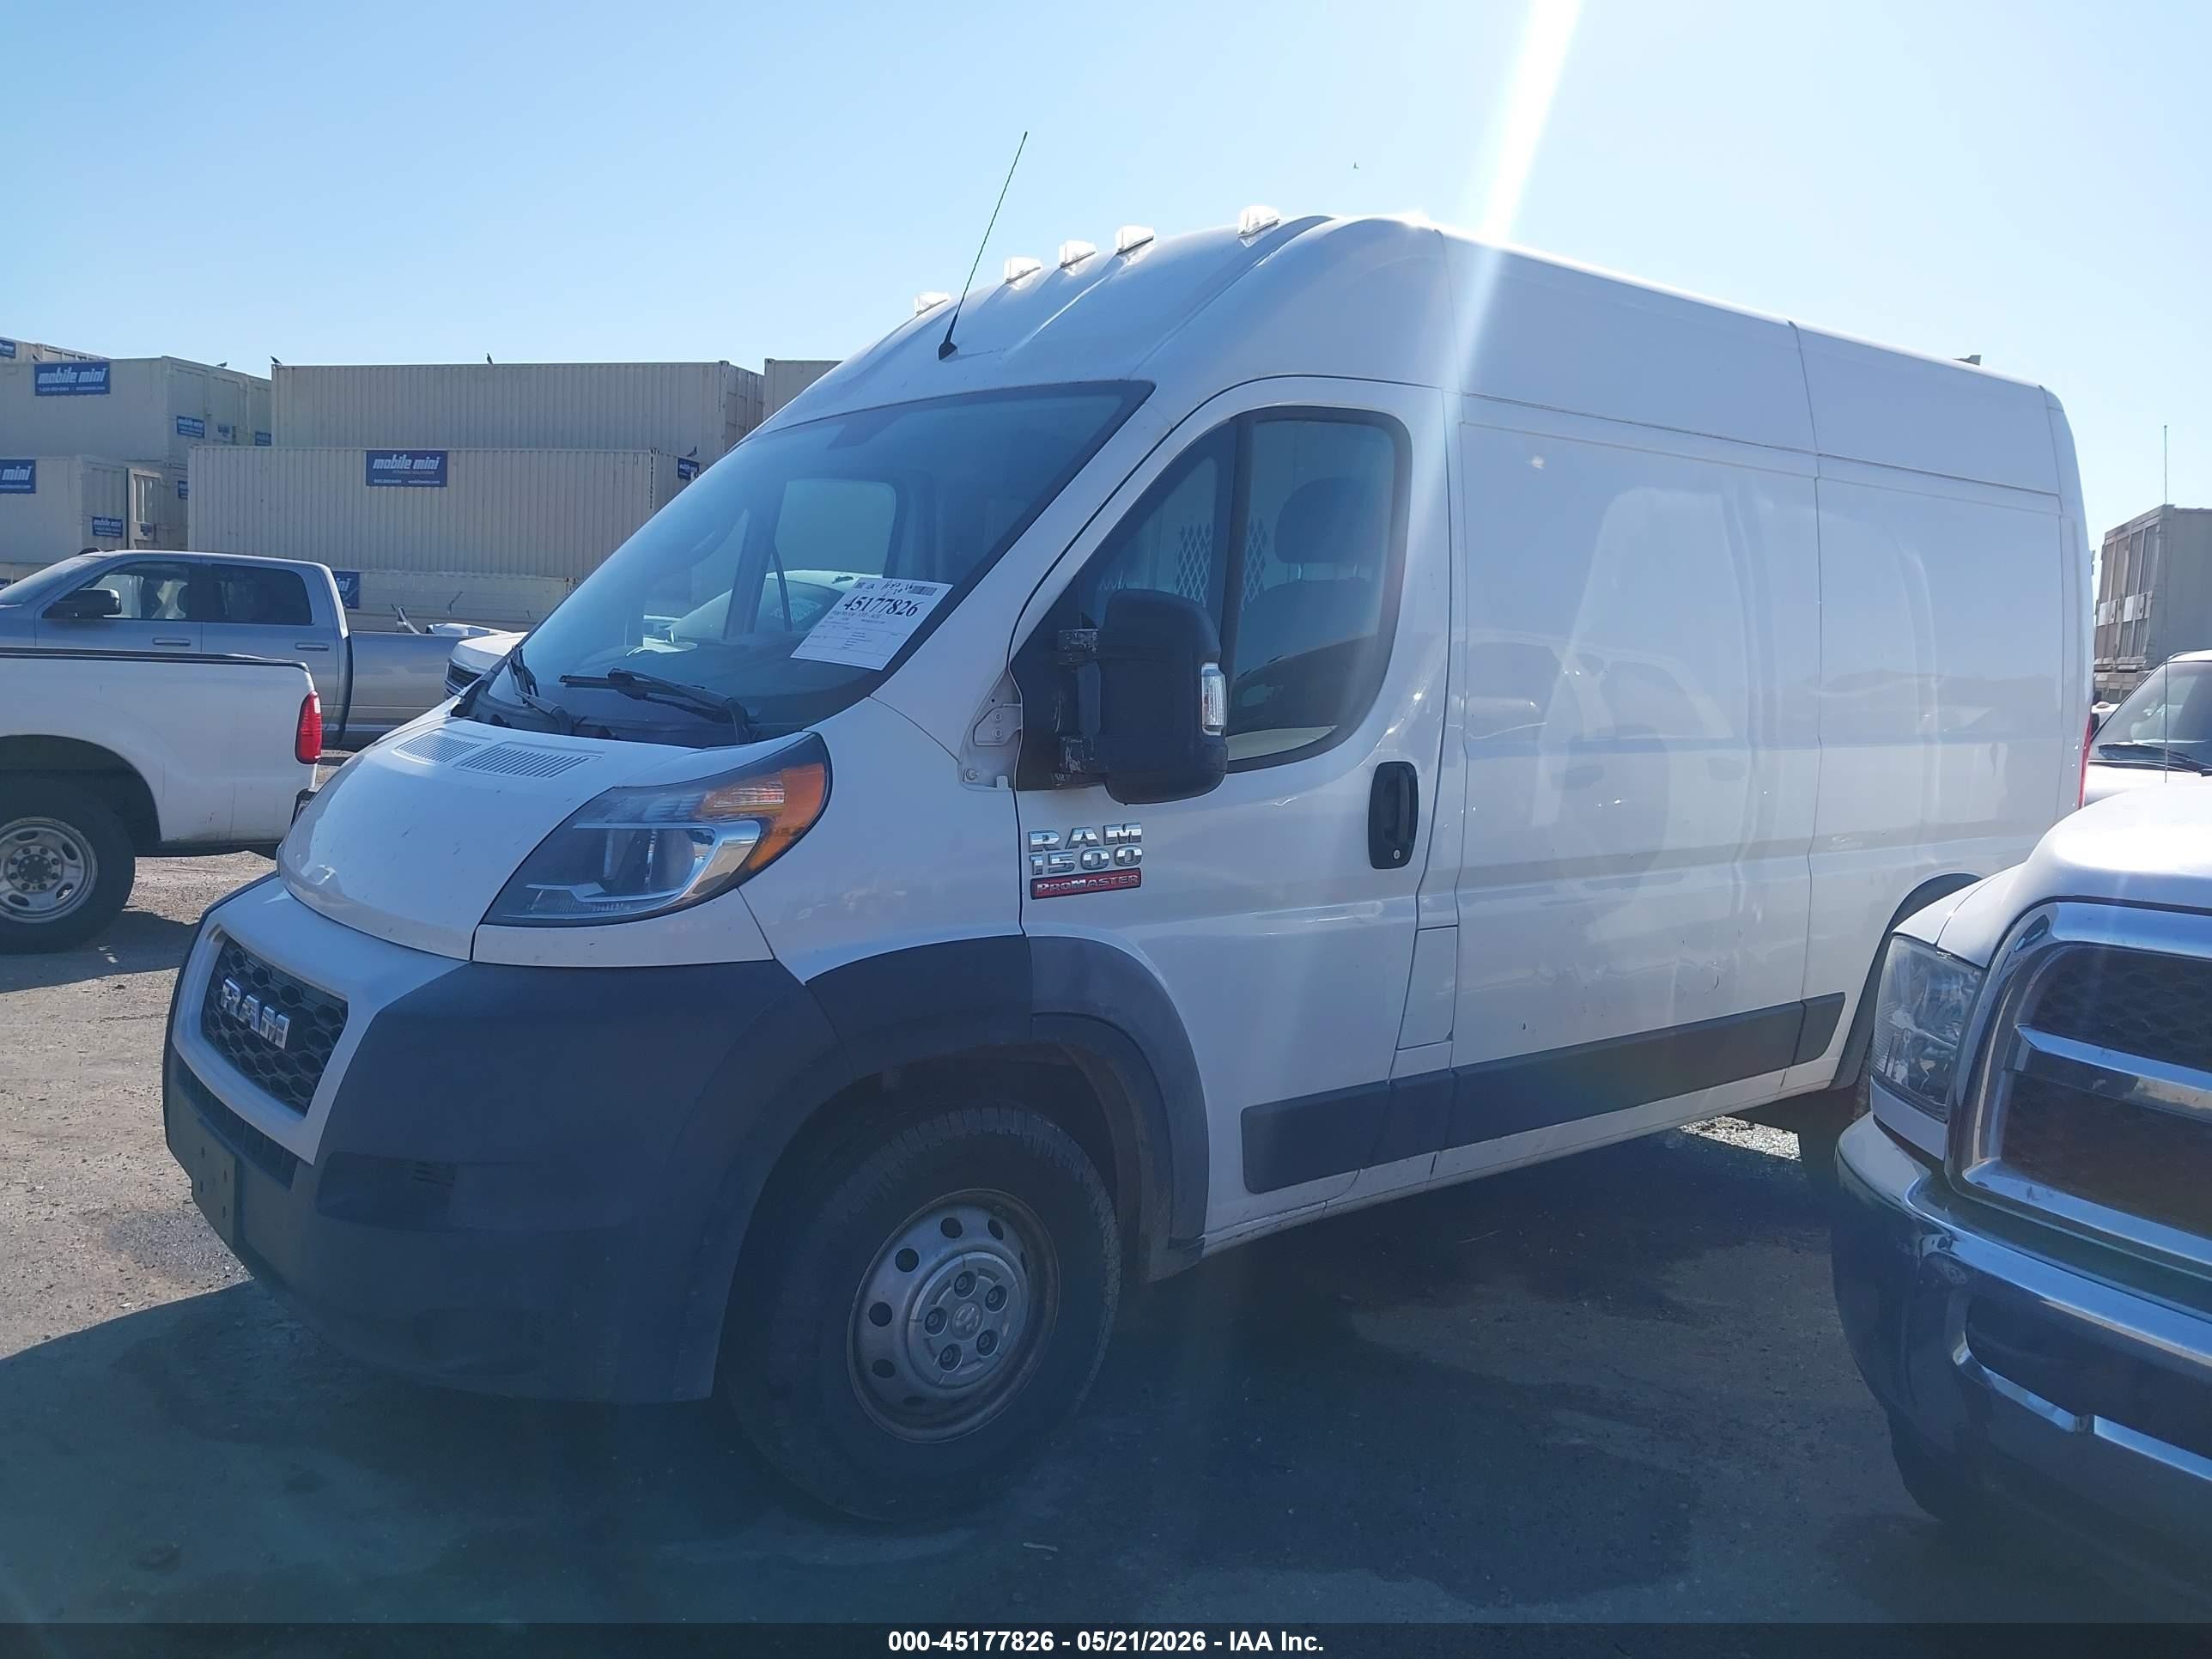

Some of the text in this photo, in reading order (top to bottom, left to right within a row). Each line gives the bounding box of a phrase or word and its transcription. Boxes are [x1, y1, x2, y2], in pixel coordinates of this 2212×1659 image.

[38, 367, 106, 385] mobile mini
[373, 453, 441, 470] mobile mini
[2, 465, 32, 481] mini
[844, 596, 925, 617] 45177826
[1028, 823, 1142, 853] RAM
[1030, 845, 1143, 876] 1500
[220, 977, 291, 1050] RAM
